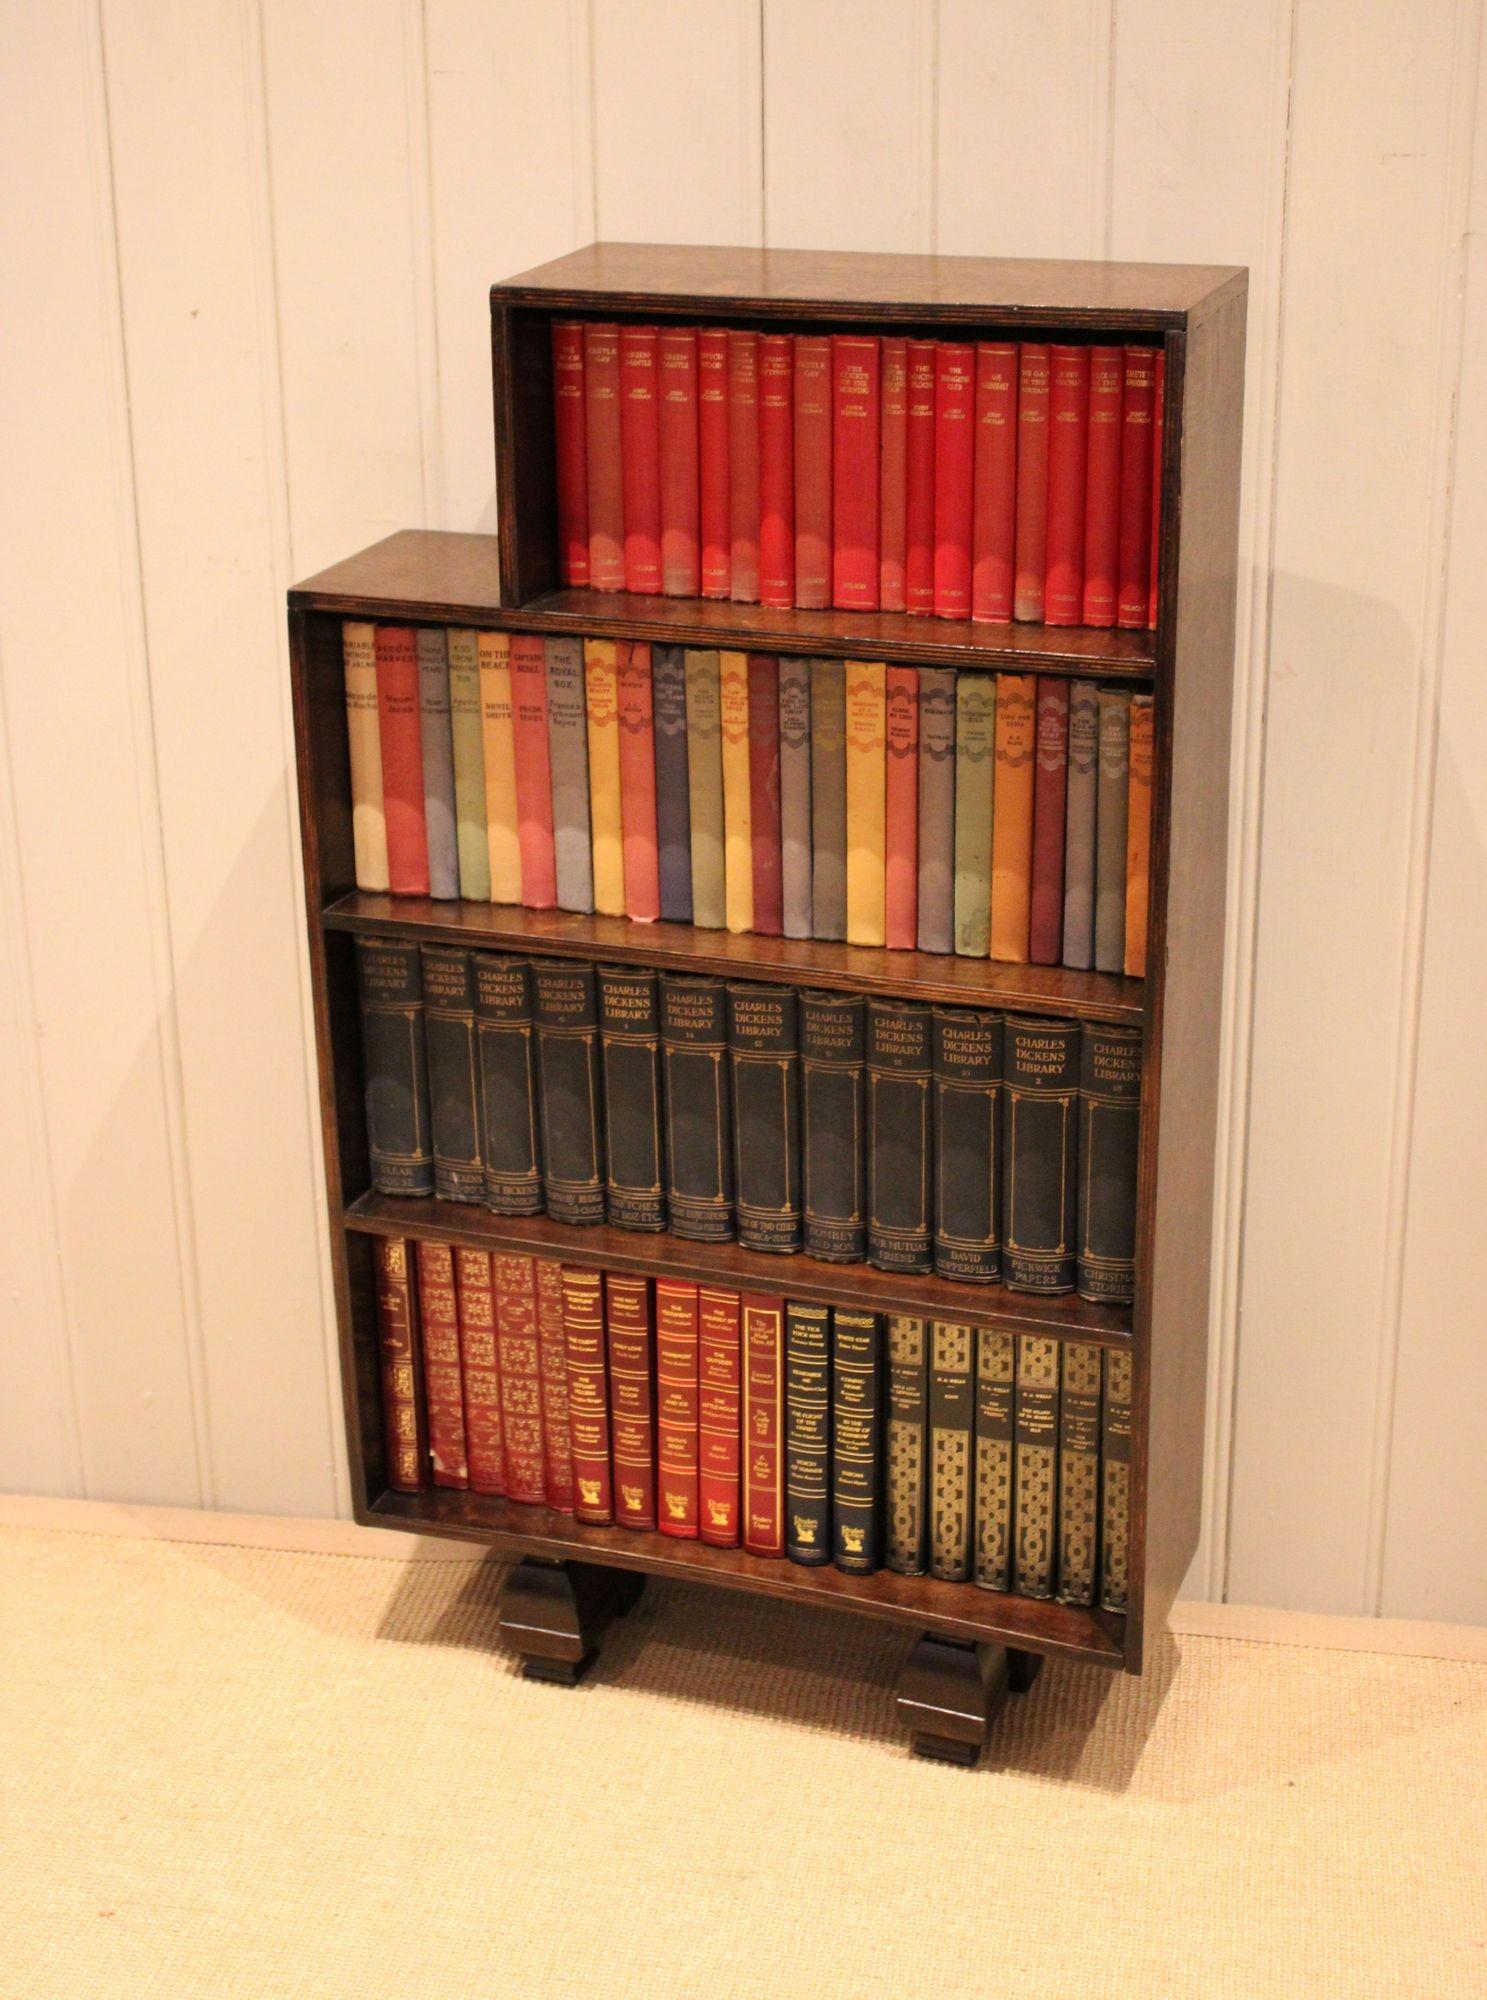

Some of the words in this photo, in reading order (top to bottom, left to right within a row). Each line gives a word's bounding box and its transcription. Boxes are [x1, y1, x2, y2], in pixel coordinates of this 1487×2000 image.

[480, 650, 493, 658] ON
[554, 655, 572, 664] THE
[549, 666, 579, 677] ROYAL
[478, 971, 523, 983] CHARLES
[479, 983, 525, 994] DICKENS
[538, 978, 584, 990] CHARLES
[603, 984, 650, 996] CHARLES
[480, 994, 523, 1007] LIBRARY
[539, 990, 586, 1001] DICKENS
[604, 996, 651, 1008] DICKENS
[666, 993, 713, 1005] CHARLES
[540, 1002, 586, 1013] LIBRARY
[605, 1007, 651, 1020] LIBRARY
[667, 1005, 714, 1017] DICKENS
[734, 1001, 782, 1013] CHARLES
[668, 1016, 714, 1029] LIBRARY
[735, 1013, 783, 1025] DICKENS
[805, 1010, 853, 1023] CHARLES
[735, 1025, 782, 1037] LIBRARY
[806, 1022, 854, 1035] DICKENS
[874, 1018, 923, 1031] CHARLES
[807, 1034, 853, 1047] LIBRARY
[875, 1030, 923, 1043] DICKENS
[942, 1028, 992, 1041] CHARLES
[875, 1042, 923, 1055] LIBRARY
[943, 1040, 992, 1053] DICKENS
[1015, 1037, 1066, 1050] CHARLES
[943, 1052, 992, 1066] LIBRARY
[1016, 1048, 1066, 1062] DICKENS
[1016, 1061, 1066, 1075] LIBRARY
[1034, 1077, 1042, 1086] 2
[808, 1226, 856, 1241] DOMBEY
[833, 1240, 856, 1252] SON
[888, 1239, 929, 1252] MUTUAL
[879, 1251, 916, 1263] FRIEND
[950, 1250, 981, 1263] DAVID
[937, 1260, 998, 1274] COPPERFIELD
[1011, 1260, 1061, 1273] PICKWICK
[1015, 1272, 1057, 1285] PAPERS
[1084, 1269, 1136, 1281] CHRISTMA
